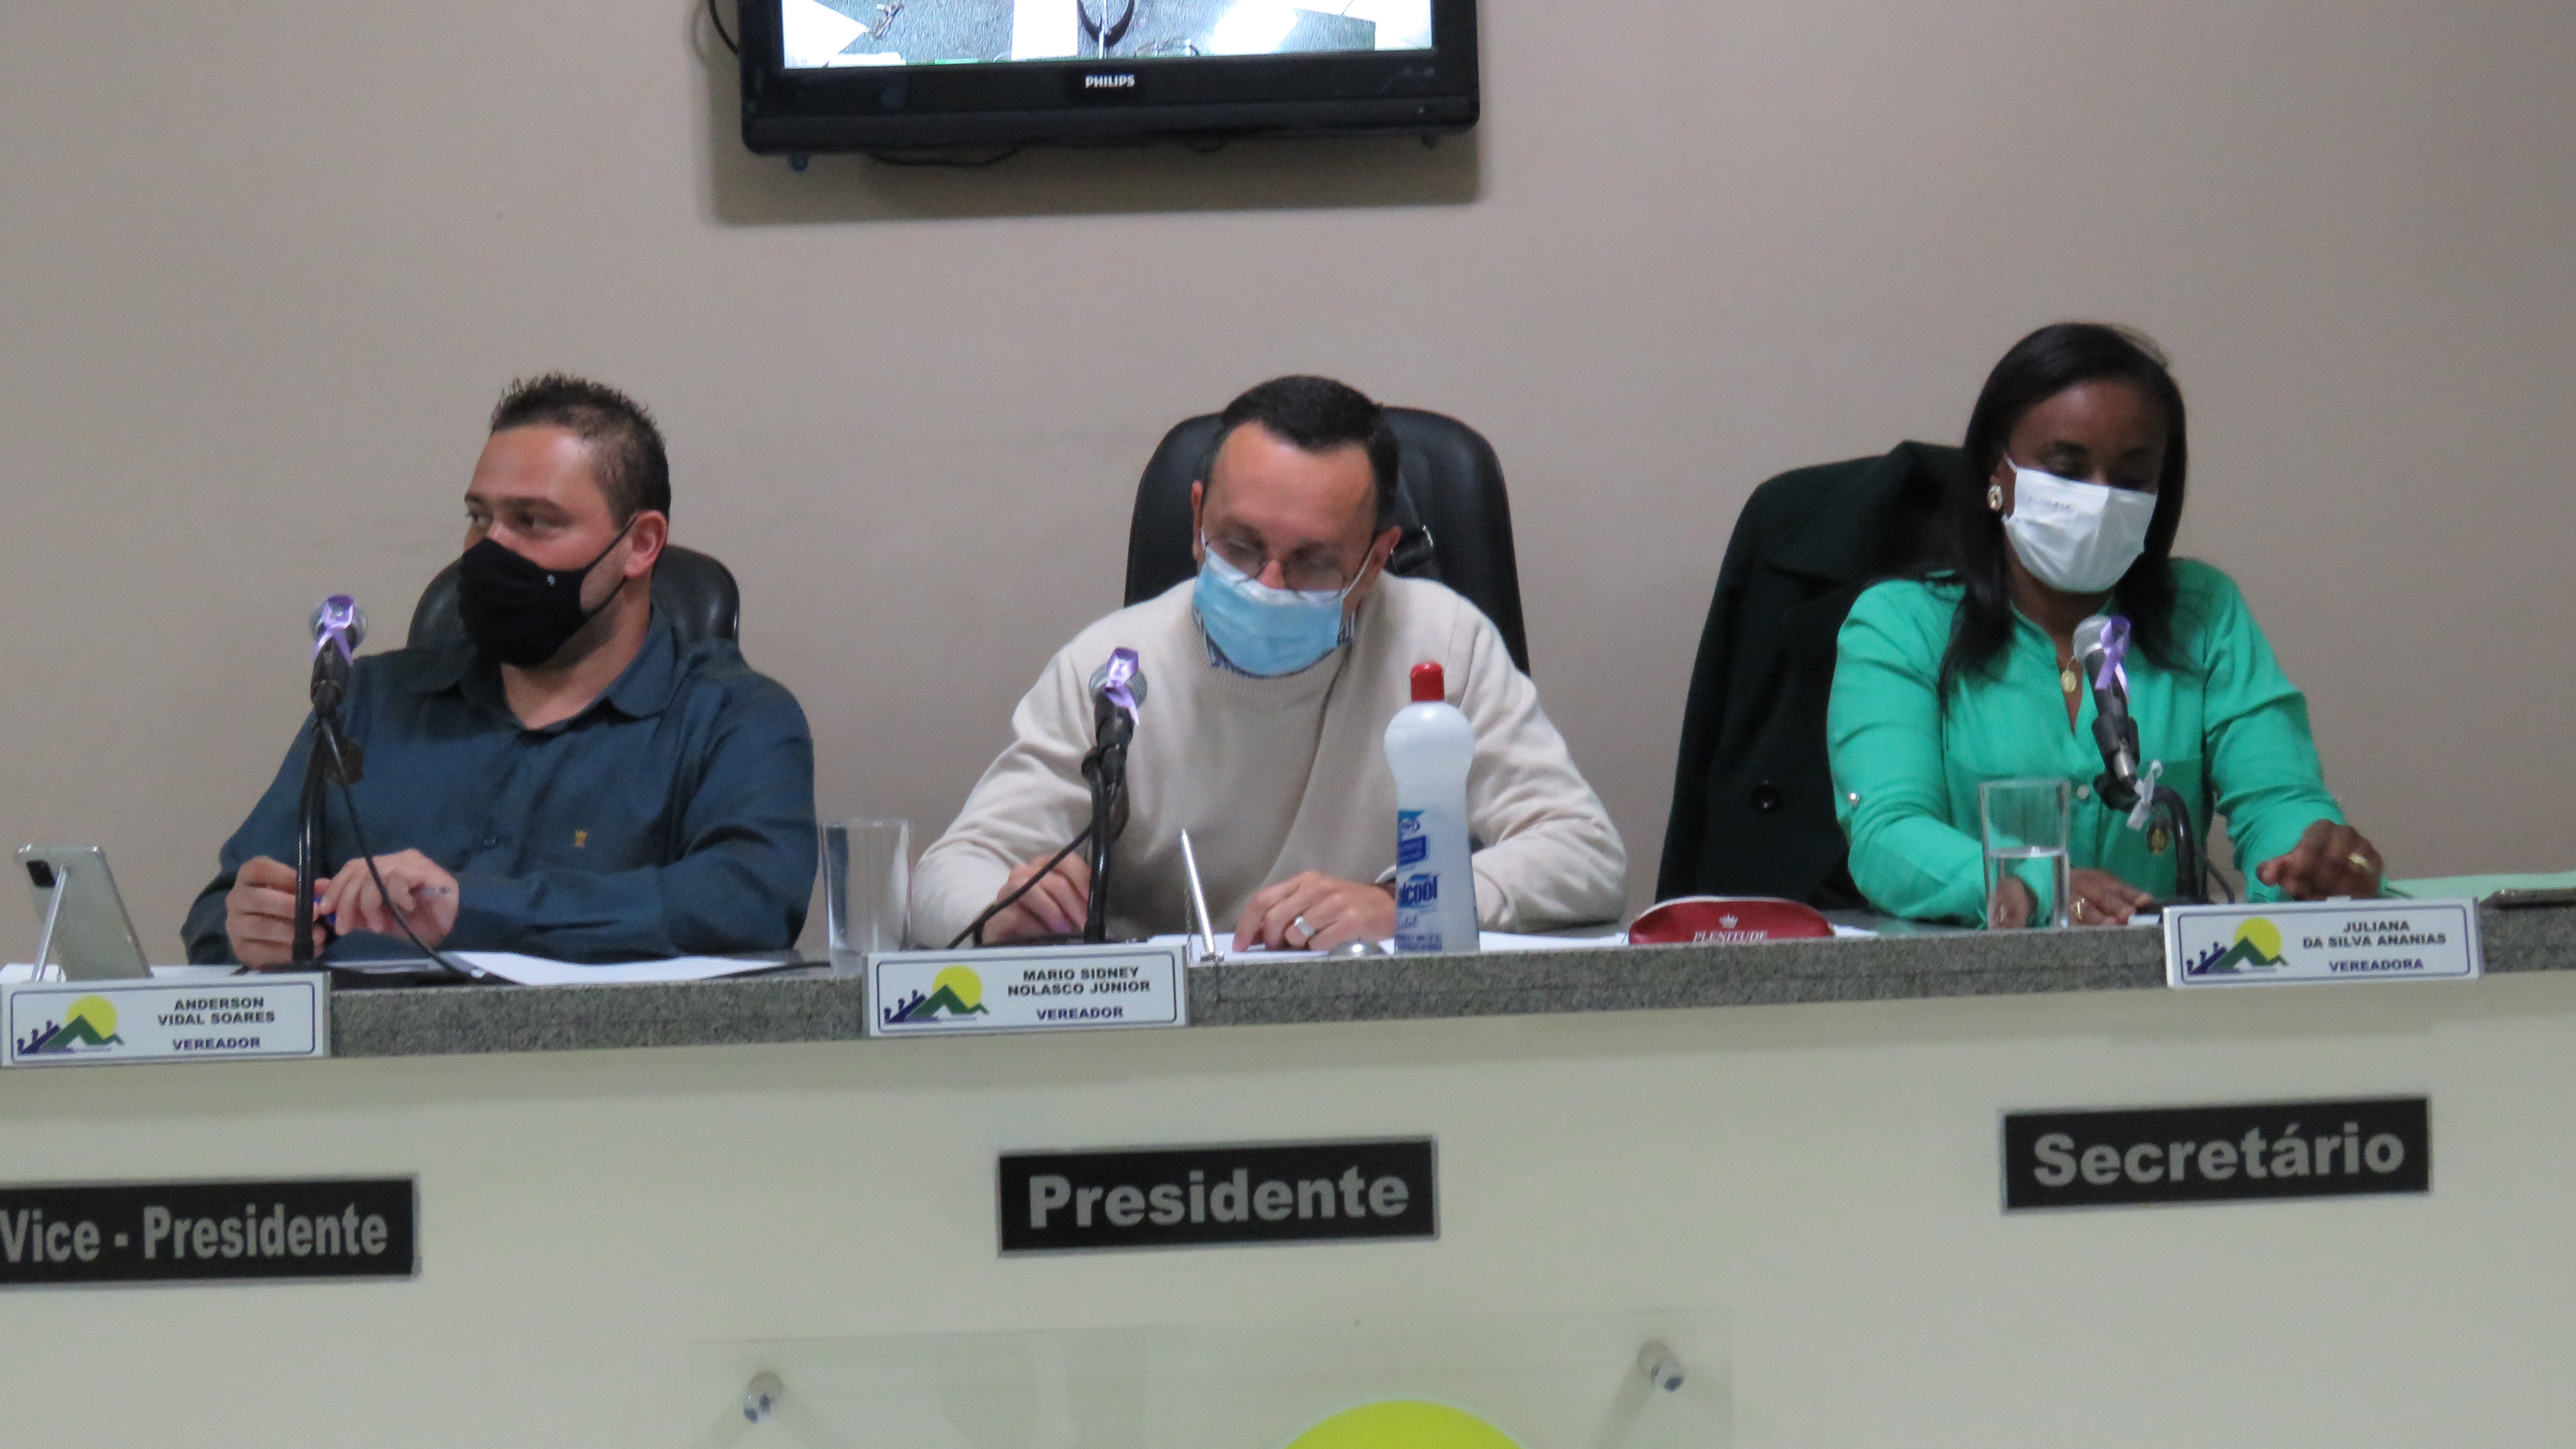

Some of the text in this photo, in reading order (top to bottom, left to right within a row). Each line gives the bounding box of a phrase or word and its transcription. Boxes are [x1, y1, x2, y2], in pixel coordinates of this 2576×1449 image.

[1085, 74, 1135, 88] PHILIPS
[2343, 920, 2410, 932] JULIANA
[1693, 931, 1768, 944] PLENITUDE
[2303, 932, 2446, 949] DA SILVA ANANIAS
[2329, 958, 2424, 972] VEREADORA
[1022, 965, 1139, 982] MARIO SIDNEY
[1008, 983, 1085, 997] NOLASCO
[174, 996, 264, 1011] ANDERSON
[158, 1010, 275, 1026] VIDAL SOARES
[1036, 1006, 1123, 1020] VEREADOR
[172, 1037, 261, 1051] VEREADOR
[2033, 1121, 2405, 1187] Secretário
[1029, 1166, 1409, 1229] Presidente
[0, 1208, 100, 1263] Vice
[143, 1202, 388, 1259] Presidente
